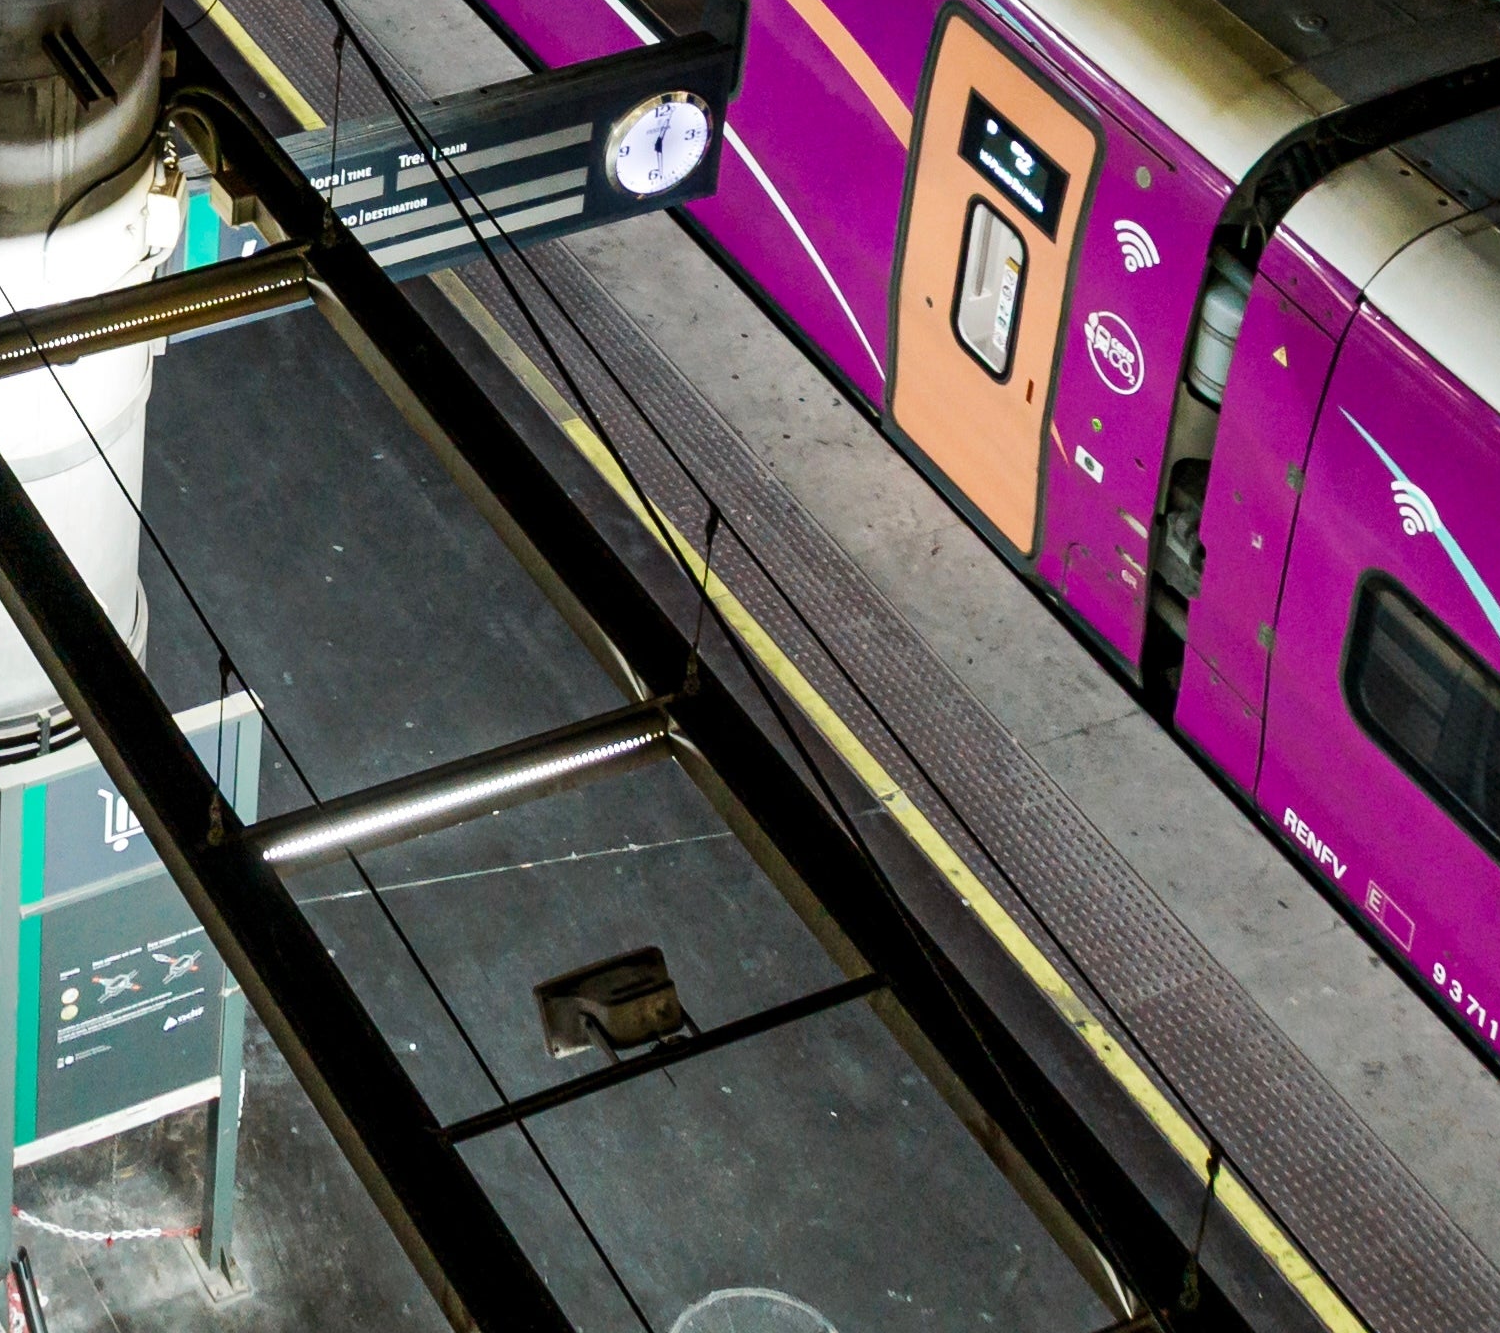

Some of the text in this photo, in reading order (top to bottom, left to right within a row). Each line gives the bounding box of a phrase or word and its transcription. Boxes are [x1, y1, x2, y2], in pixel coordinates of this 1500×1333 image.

[347, 166, 373, 181] TIME
[365, 197, 428, 221] DESTINATION
[1283, 807, 1348, 881] RENFV
[1369, 888, 1382, 913] E
